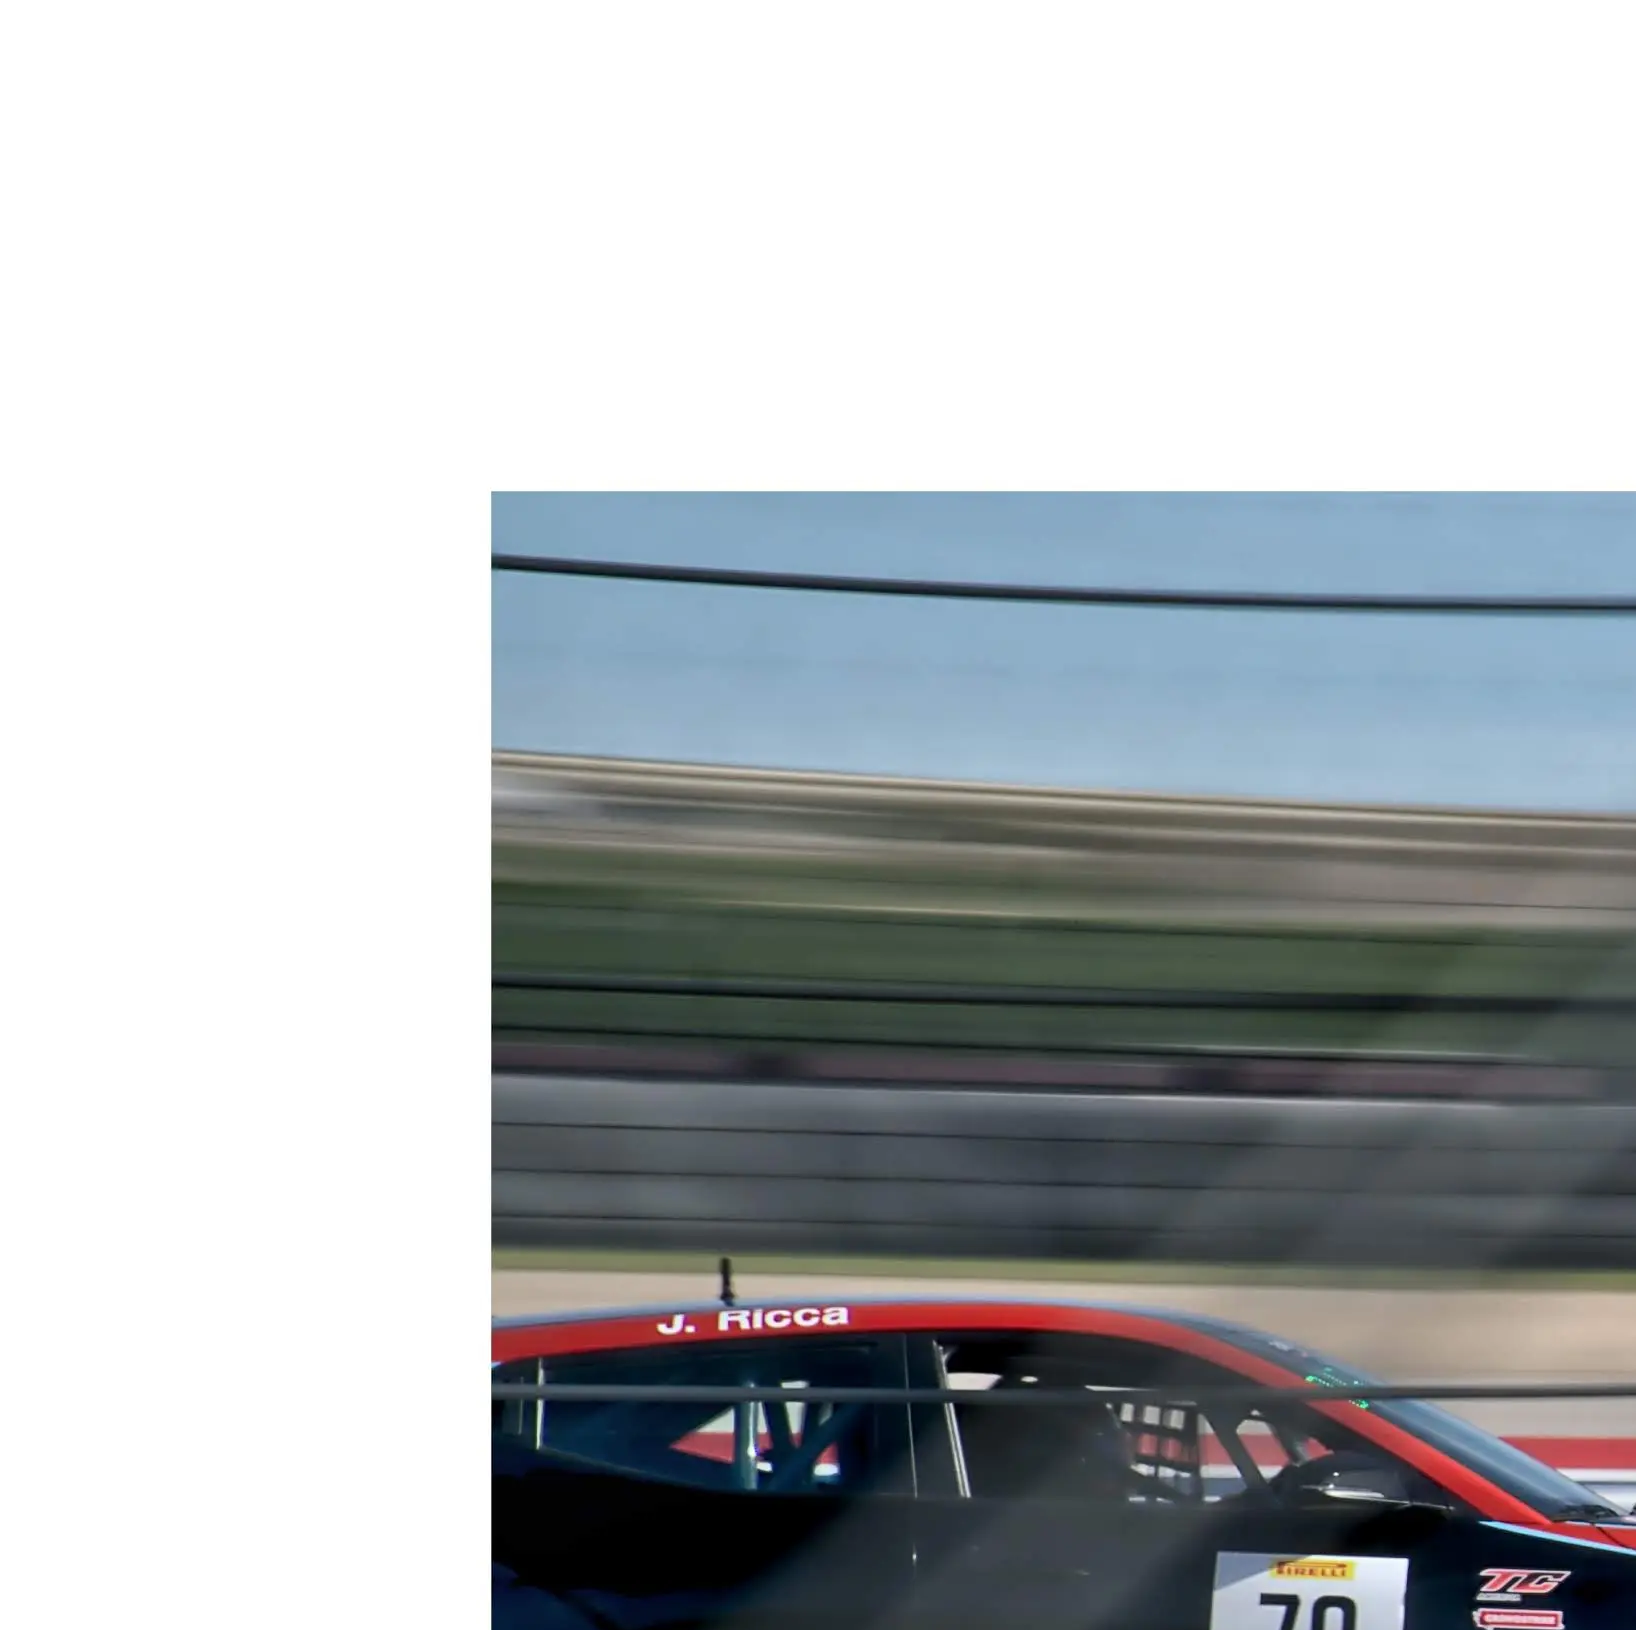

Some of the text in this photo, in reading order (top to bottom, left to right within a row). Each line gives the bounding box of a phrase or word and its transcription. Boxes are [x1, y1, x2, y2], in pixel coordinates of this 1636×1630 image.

[656, 1306, 849, 1335] J. Ricca
[1479, 1568, 1572, 1594] TC
